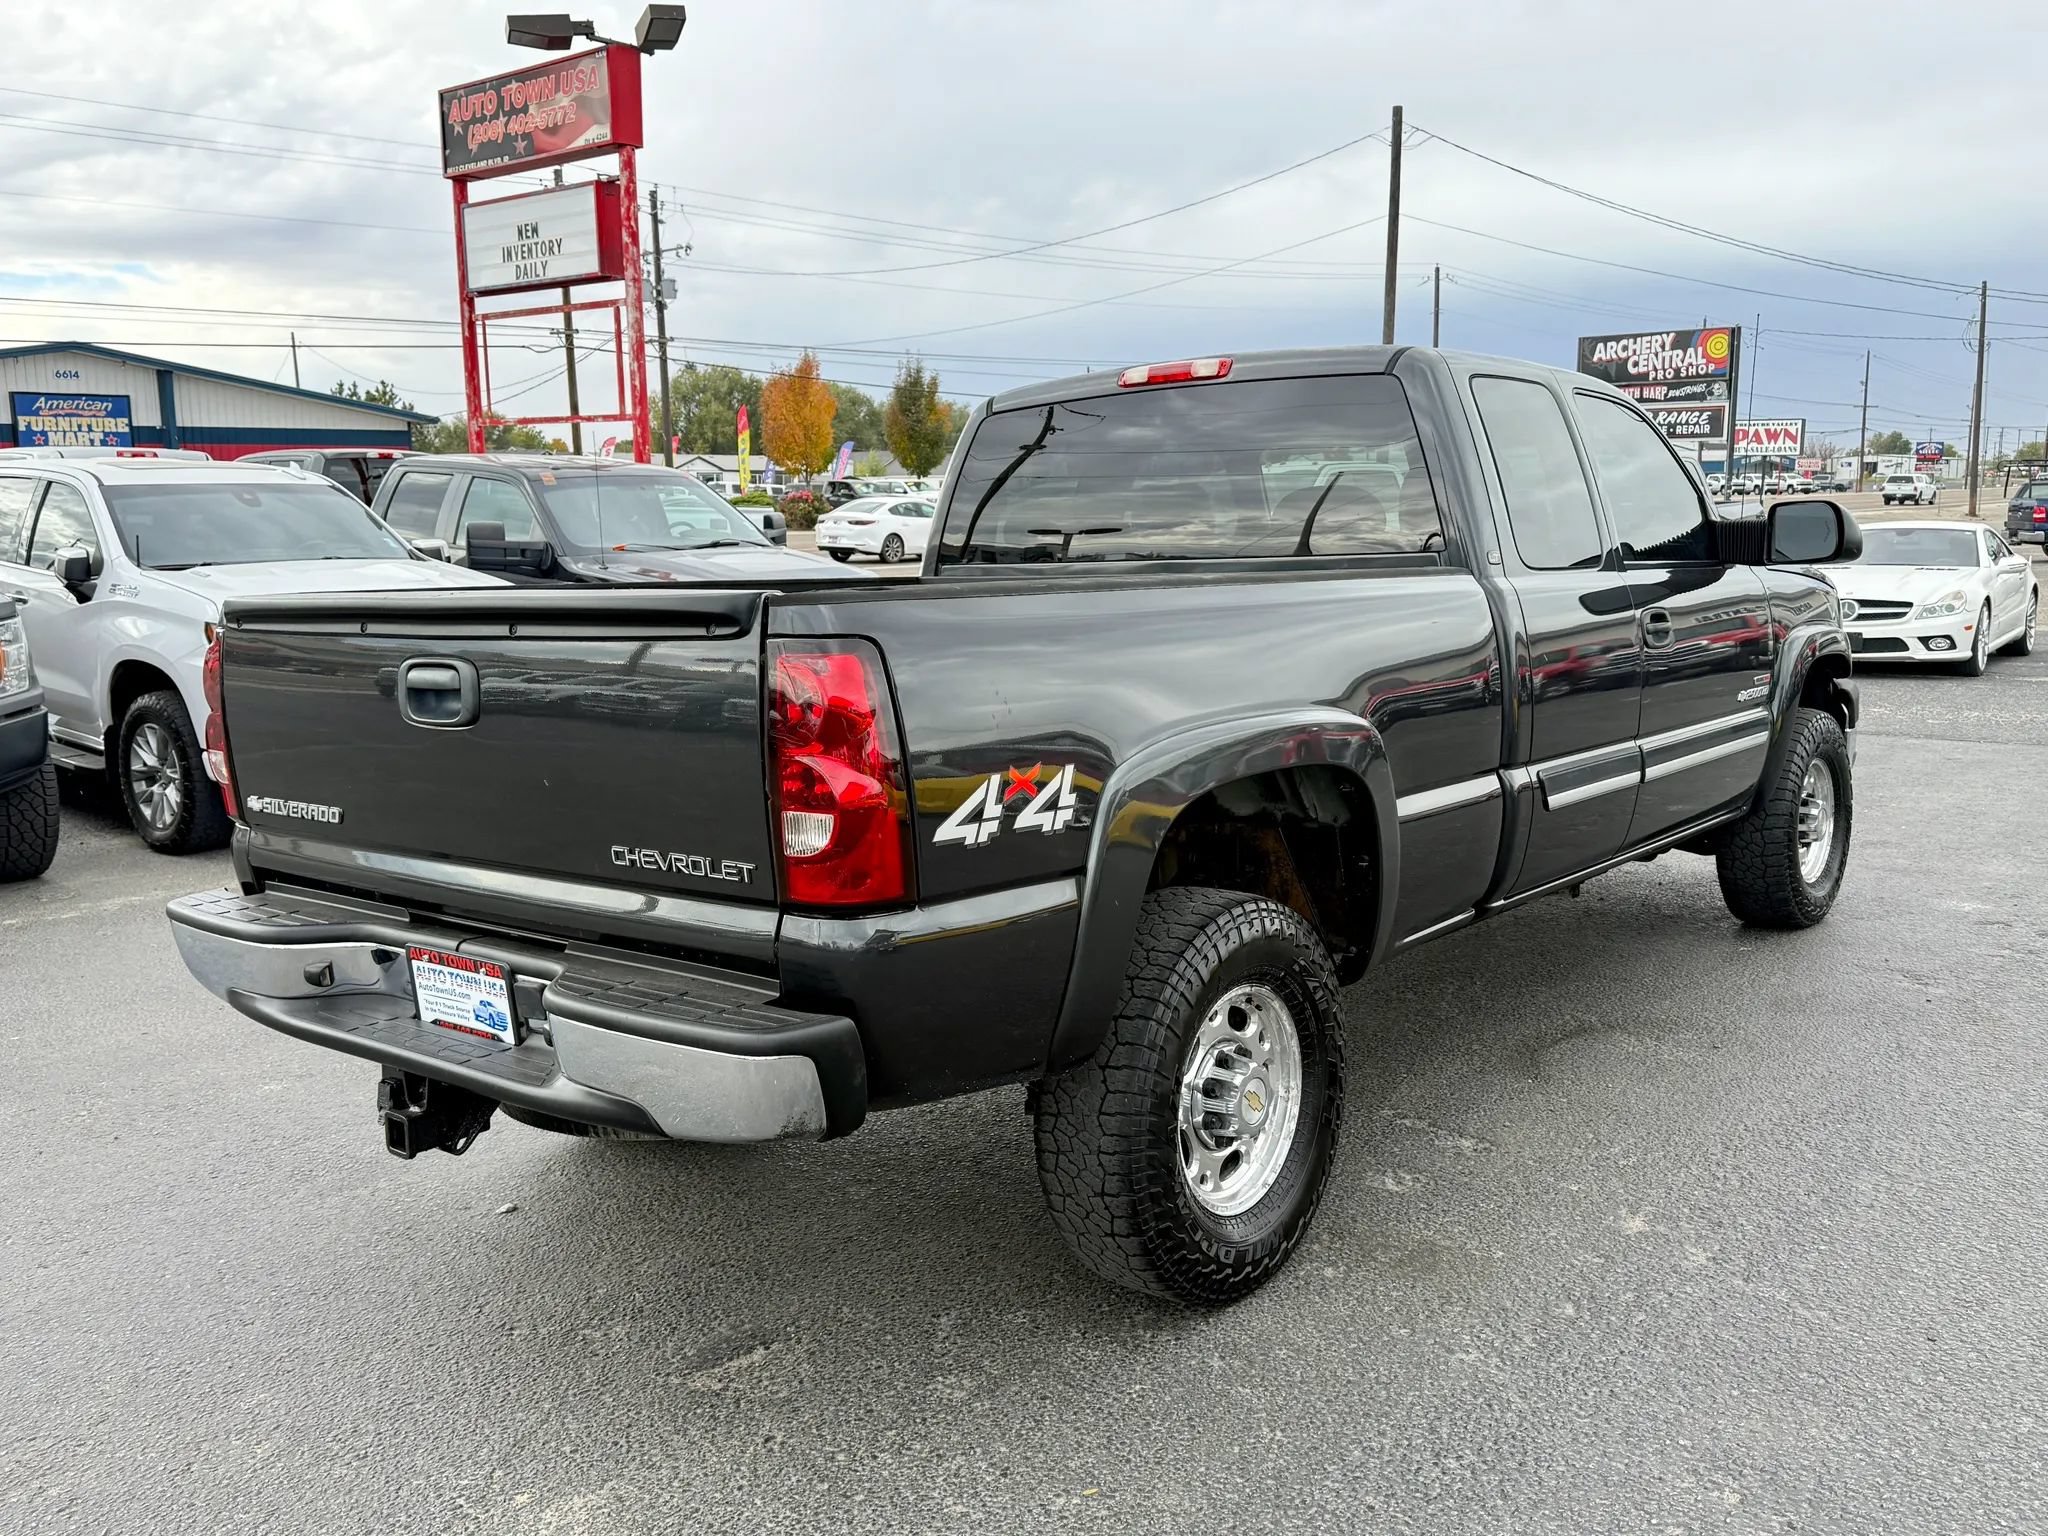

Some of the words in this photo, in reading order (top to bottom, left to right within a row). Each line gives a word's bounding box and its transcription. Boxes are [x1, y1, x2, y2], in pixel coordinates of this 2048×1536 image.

[448, 89, 497, 124] AUTO
[501, 75, 555, 111] TOWN
[560, 64, 600, 97] USA
[467, 118, 504, 148] (208)
[507, 101, 577, 136] 402-5772
[517, 222, 539, 241] NEW
[502, 238, 562, 263] INVENTORY
[515, 260, 548, 281] DAILY
[1592, 332, 1676, 363] ARCHERY
[1627, 346, 1706, 375] CENTRAL
[54, 369, 80, 380] 6614
[1648, 368, 1675, 381] PRO
[1680, 363, 1716, 377] SHOP
[1642, 385, 1668, 400] HARP
[32, 396, 113, 412] American
[17, 415, 130, 433] FURNITURE
[1655, 410, 1712, 425] RANGE
[48, 431, 104, 447] MART
[1676, 424, 1711, 435] REPAIR
[1735, 427, 1799, 445] PAWN
[262, 797, 343, 824] SILVERADO
[611, 845, 757, 884] CHEVROLET
[409, 946, 440, 965] AUTO
[441, 953, 476, 972] TOWN
[477, 961, 503, 978] USA
